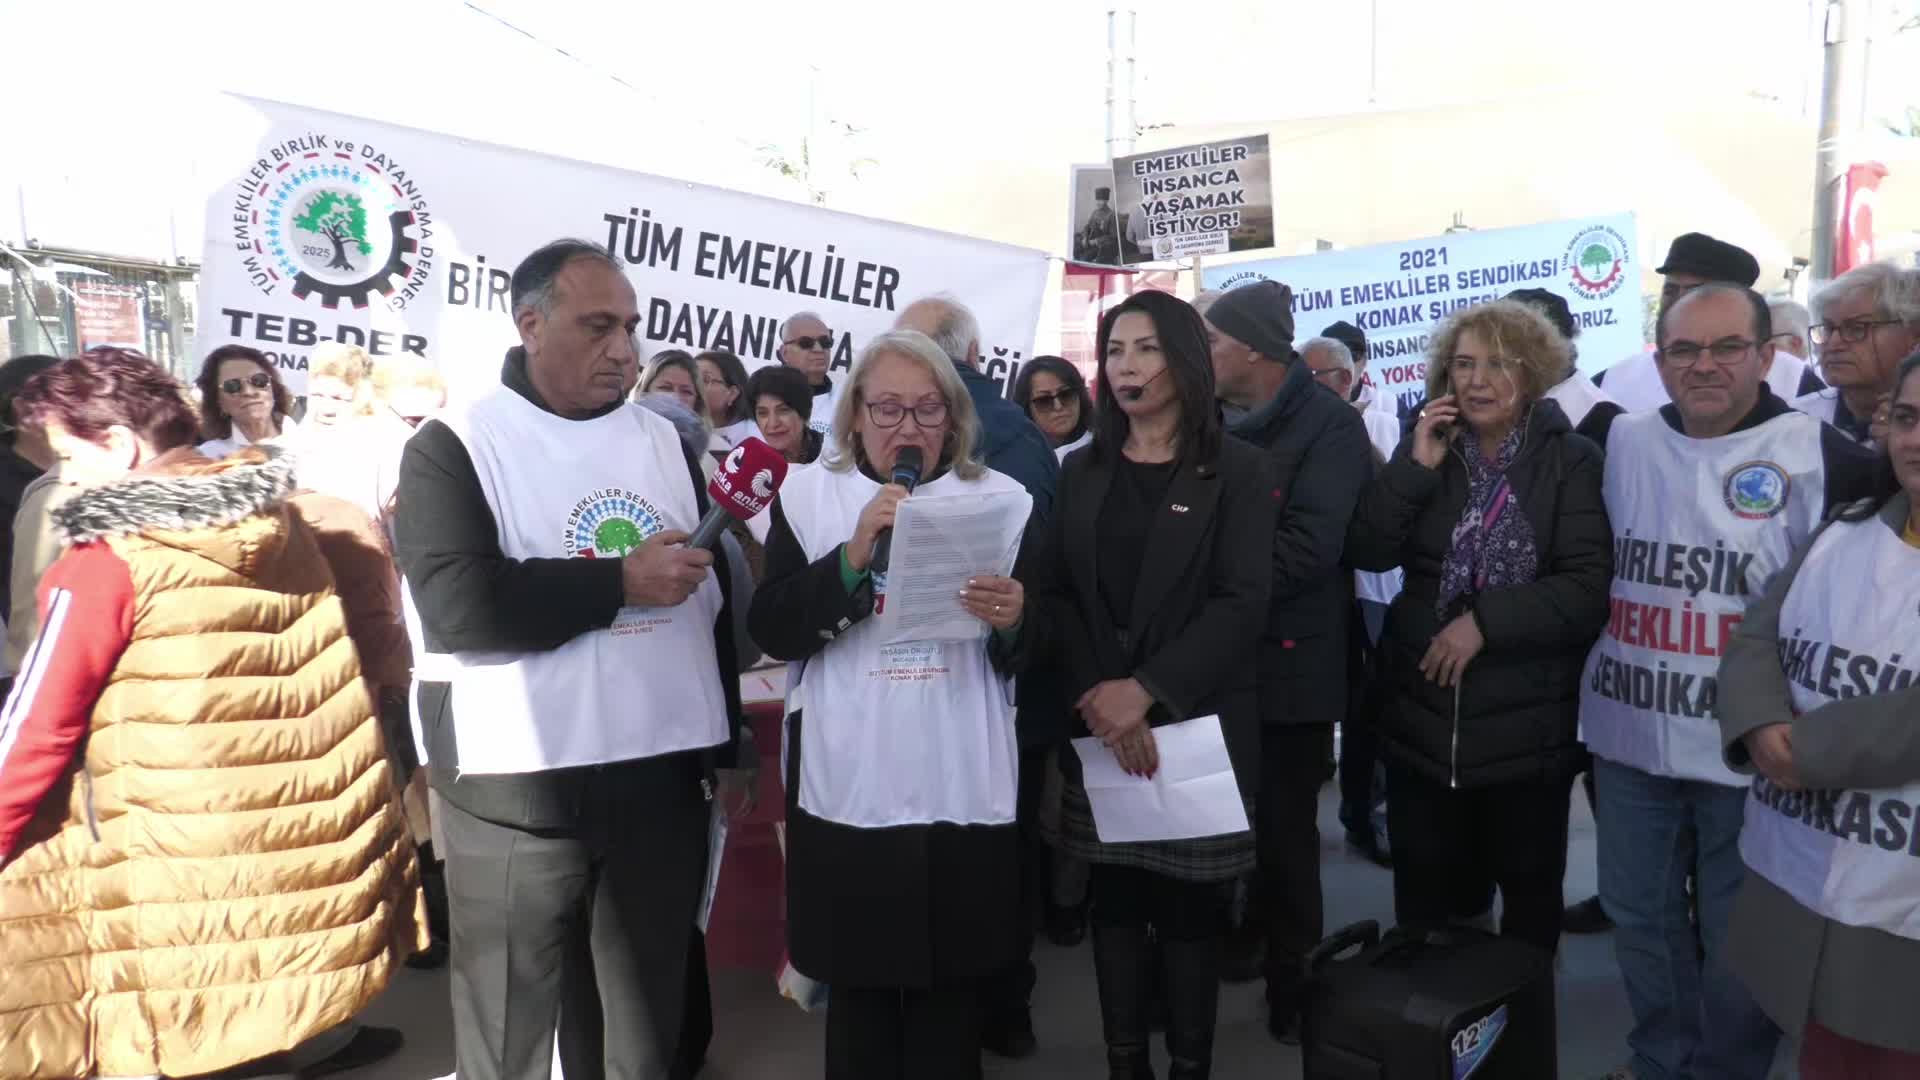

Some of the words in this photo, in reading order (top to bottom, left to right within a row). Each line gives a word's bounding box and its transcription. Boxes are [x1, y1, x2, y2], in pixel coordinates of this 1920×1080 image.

[271, 132, 328, 162] BİRLİK
[334, 140, 354, 152] ve
[1134, 145, 1247, 175] EMEKLİLER
[361, 144, 433, 239] DAYANIŞMA
[1143, 169, 1240, 195] İNSANCA
[234, 158, 272, 251] EMEKLİLER
[1142, 190, 1244, 217] YAŞAMAK
[1149, 212, 1238, 236] İSTİYOR!
[303, 245, 331, 258] 2025
[604, 207, 683, 272] TÜM
[695, 231, 900, 311] EMEKLİLER
[1400, 247, 1447, 270] 2021
[242, 256, 276, 296] TÜM
[448, 255, 512, 315] BİR
[1291, 287, 1333, 313] TÜM
[1341, 273, 1449, 306] EMEKLİLER
[1457, 258, 1558, 287] SENDİKASI
[1356, 303, 1423, 330] KONAK
[221, 308, 428, 358] TEB-DER
[646, 297, 851, 373] DAYANIA
[263, 350, 309, 371] ONA
[1366, 335, 1429, 361] İNSANC
[1381, 363, 1426, 384] YOKS
[568, 488, 622, 526] EMEKLİLER
[733, 490, 764, 511] anka
